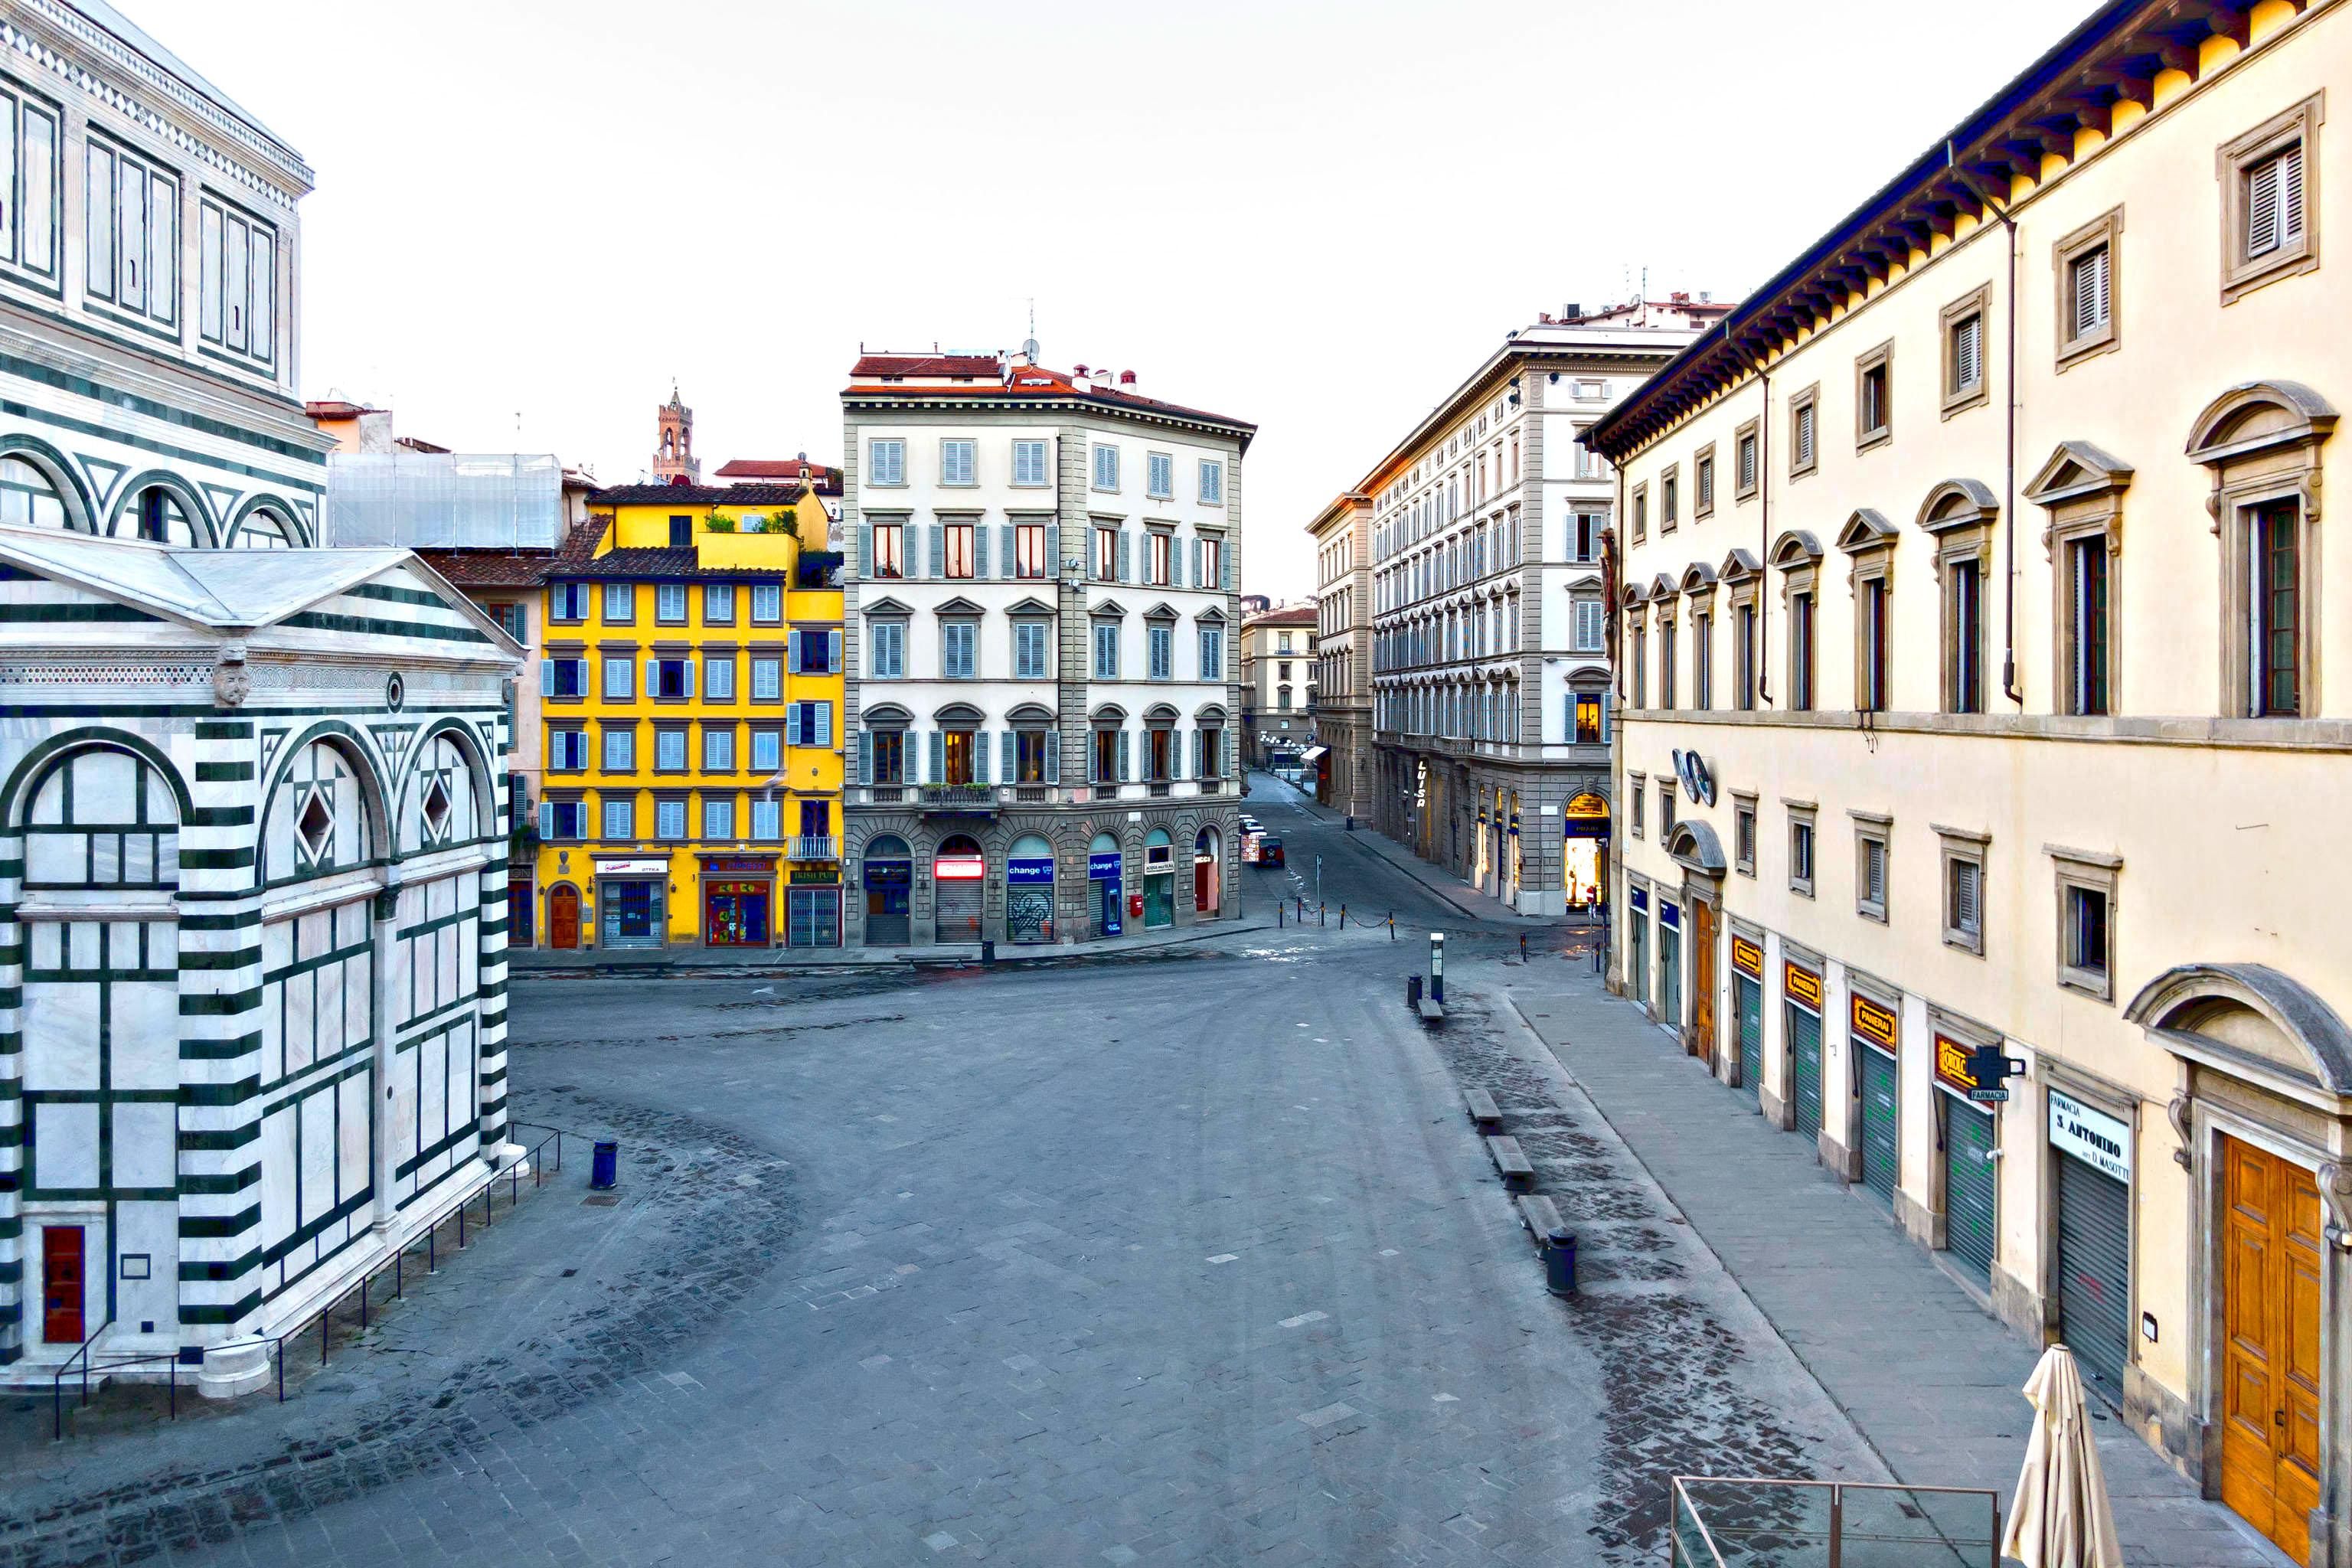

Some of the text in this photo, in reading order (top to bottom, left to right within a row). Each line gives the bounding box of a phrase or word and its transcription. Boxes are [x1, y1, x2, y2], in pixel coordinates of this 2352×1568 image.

[1416, 760, 1426, 808] LUISA
[795, 871, 816, 880] IRISH
[1009, 867, 1040, 875] change
[1090, 862, 1112, 871] change
[1793, 975, 1815, 995] PANERAI
[1861, 1010, 1889, 1032] PANERAI
[1971, 1090, 2006, 1100] FARMACIA
[2050, 1094, 2080, 1118] FARMACIA
[2057, 1114, 2121, 1158] S. ANTONINO
[2099, 1156, 2128, 1181] MASOTTI
